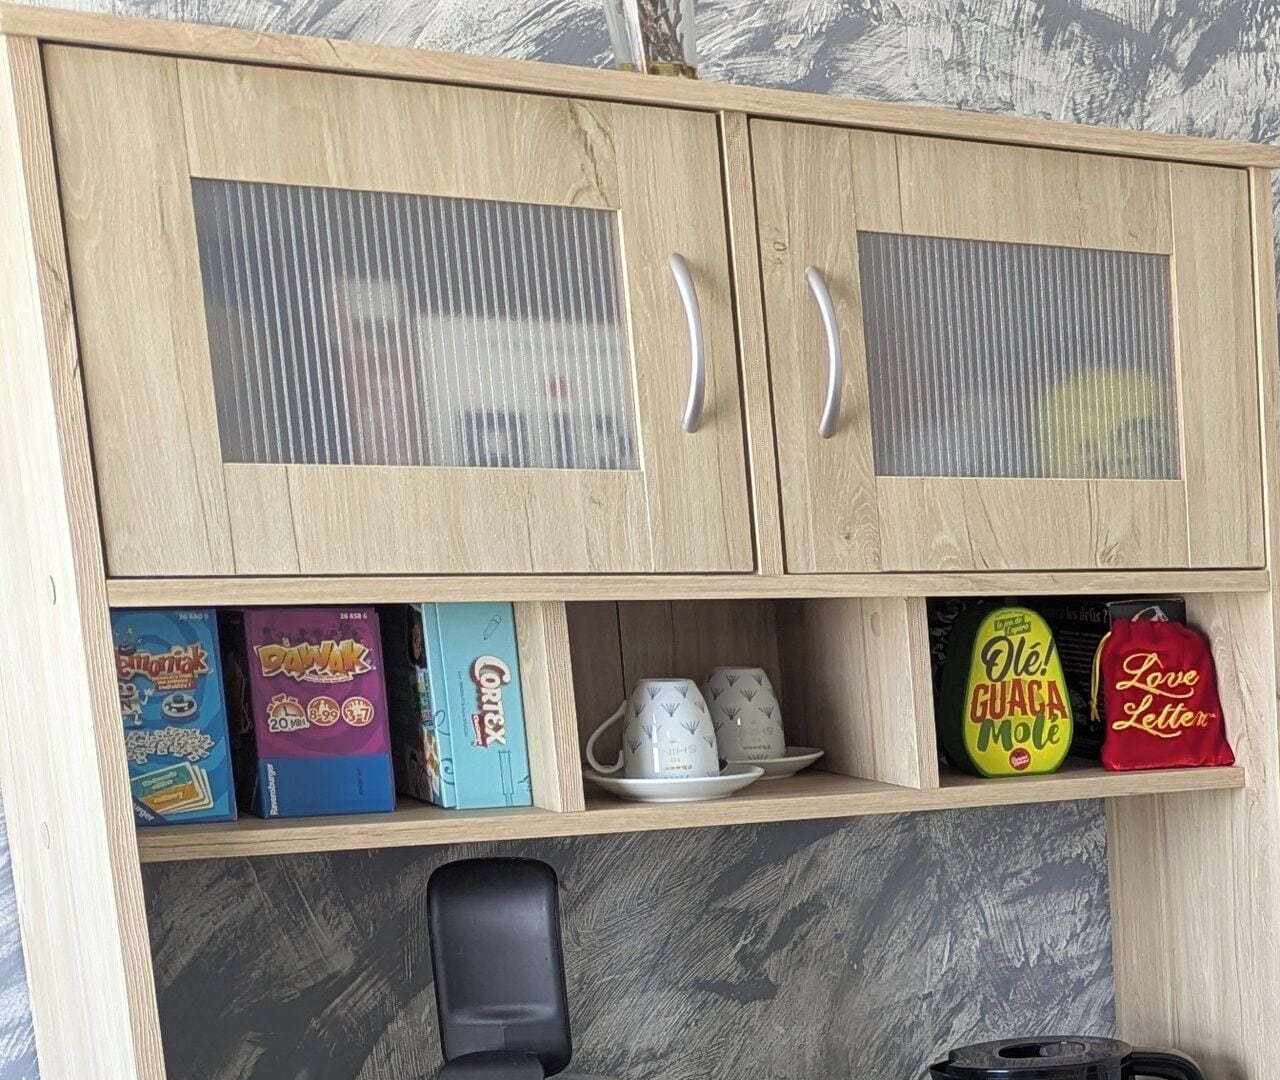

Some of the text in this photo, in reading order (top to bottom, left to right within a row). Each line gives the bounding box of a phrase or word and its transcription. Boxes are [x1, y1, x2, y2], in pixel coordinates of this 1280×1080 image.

[258, 640, 373, 679] DAWAK
[981, 635, 1054, 682] Olé!
[1115, 651, 1200, 699] Love
[309, 708, 339, 721] 8-99
[345, 708, 371, 722] 3-7
[473, 655, 511, 746] CORTEX
[970, 678, 1070, 724] GUACA
[1110, 696, 1214, 738] Letter
[270, 716, 287, 731] 20
[976, 712, 1061, 752] Molé
[266, 763, 278, 816] Ravensburger
